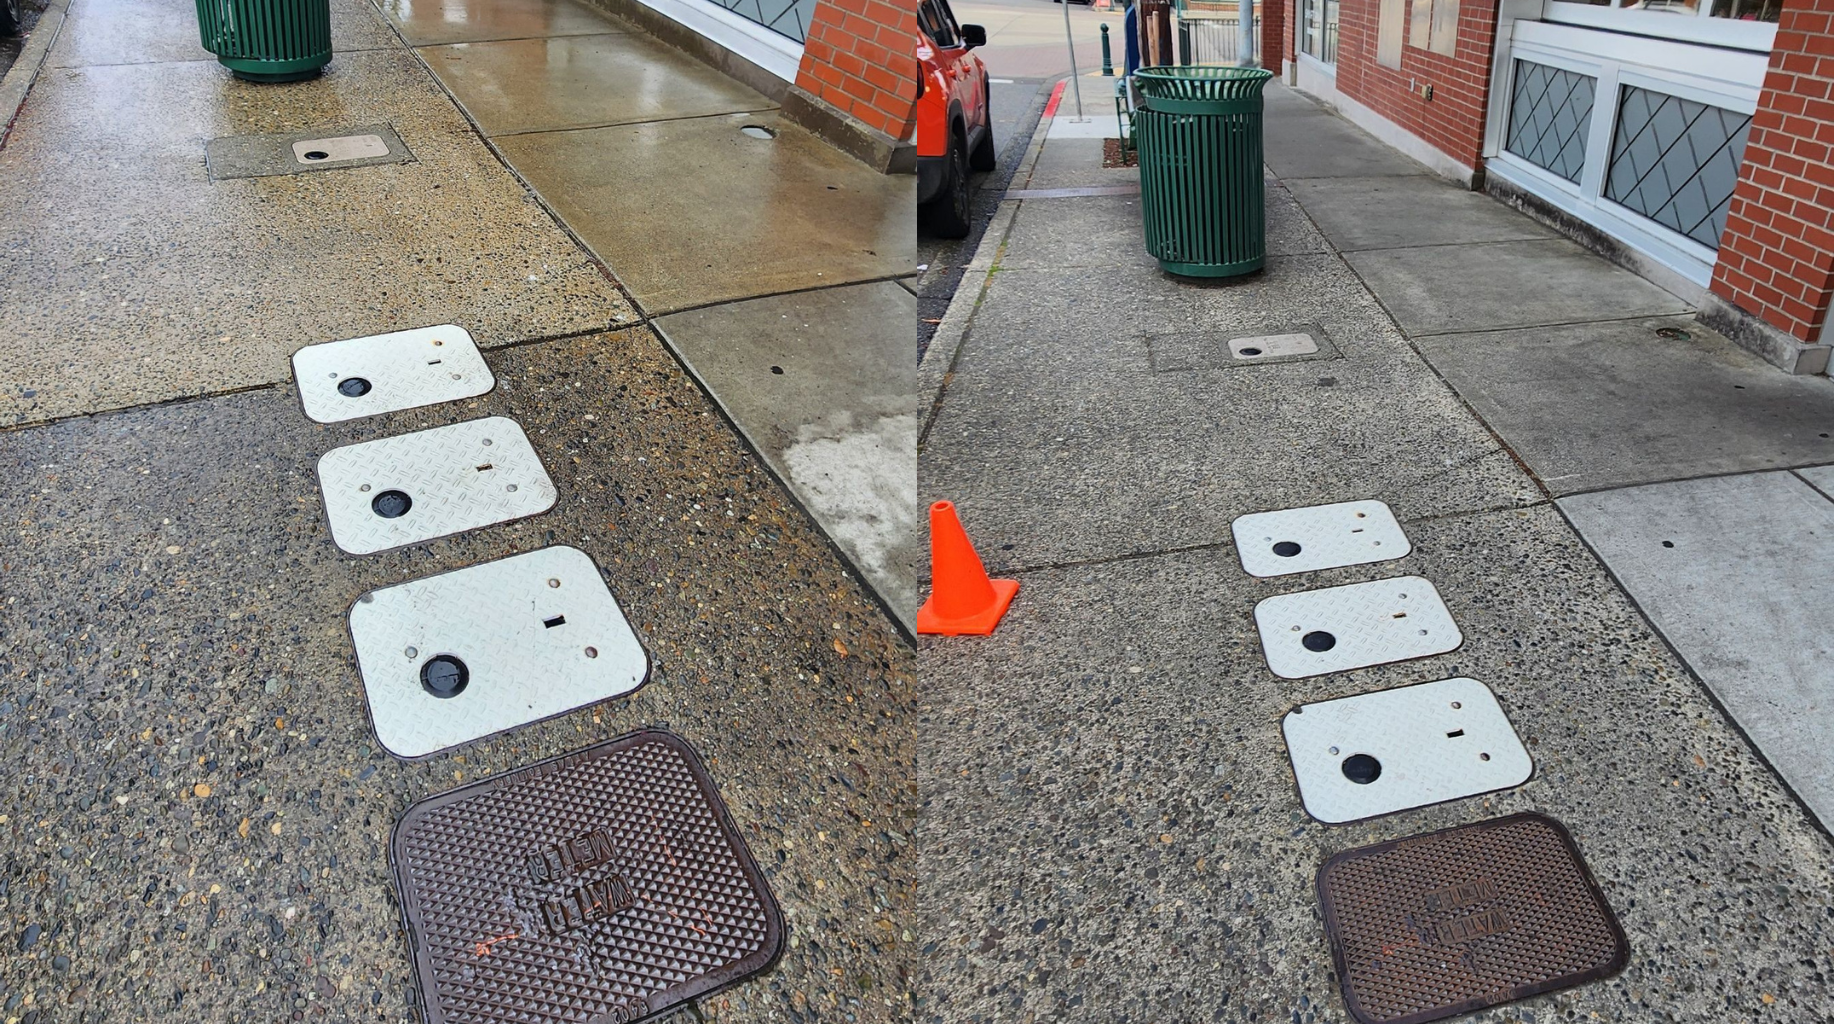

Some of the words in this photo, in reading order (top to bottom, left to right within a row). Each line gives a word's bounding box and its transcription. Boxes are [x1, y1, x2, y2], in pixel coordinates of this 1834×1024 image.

[527, 830, 616, 884] METER
[545, 875, 635, 933] WATER
[1437, 908, 1509, 943] WATER
